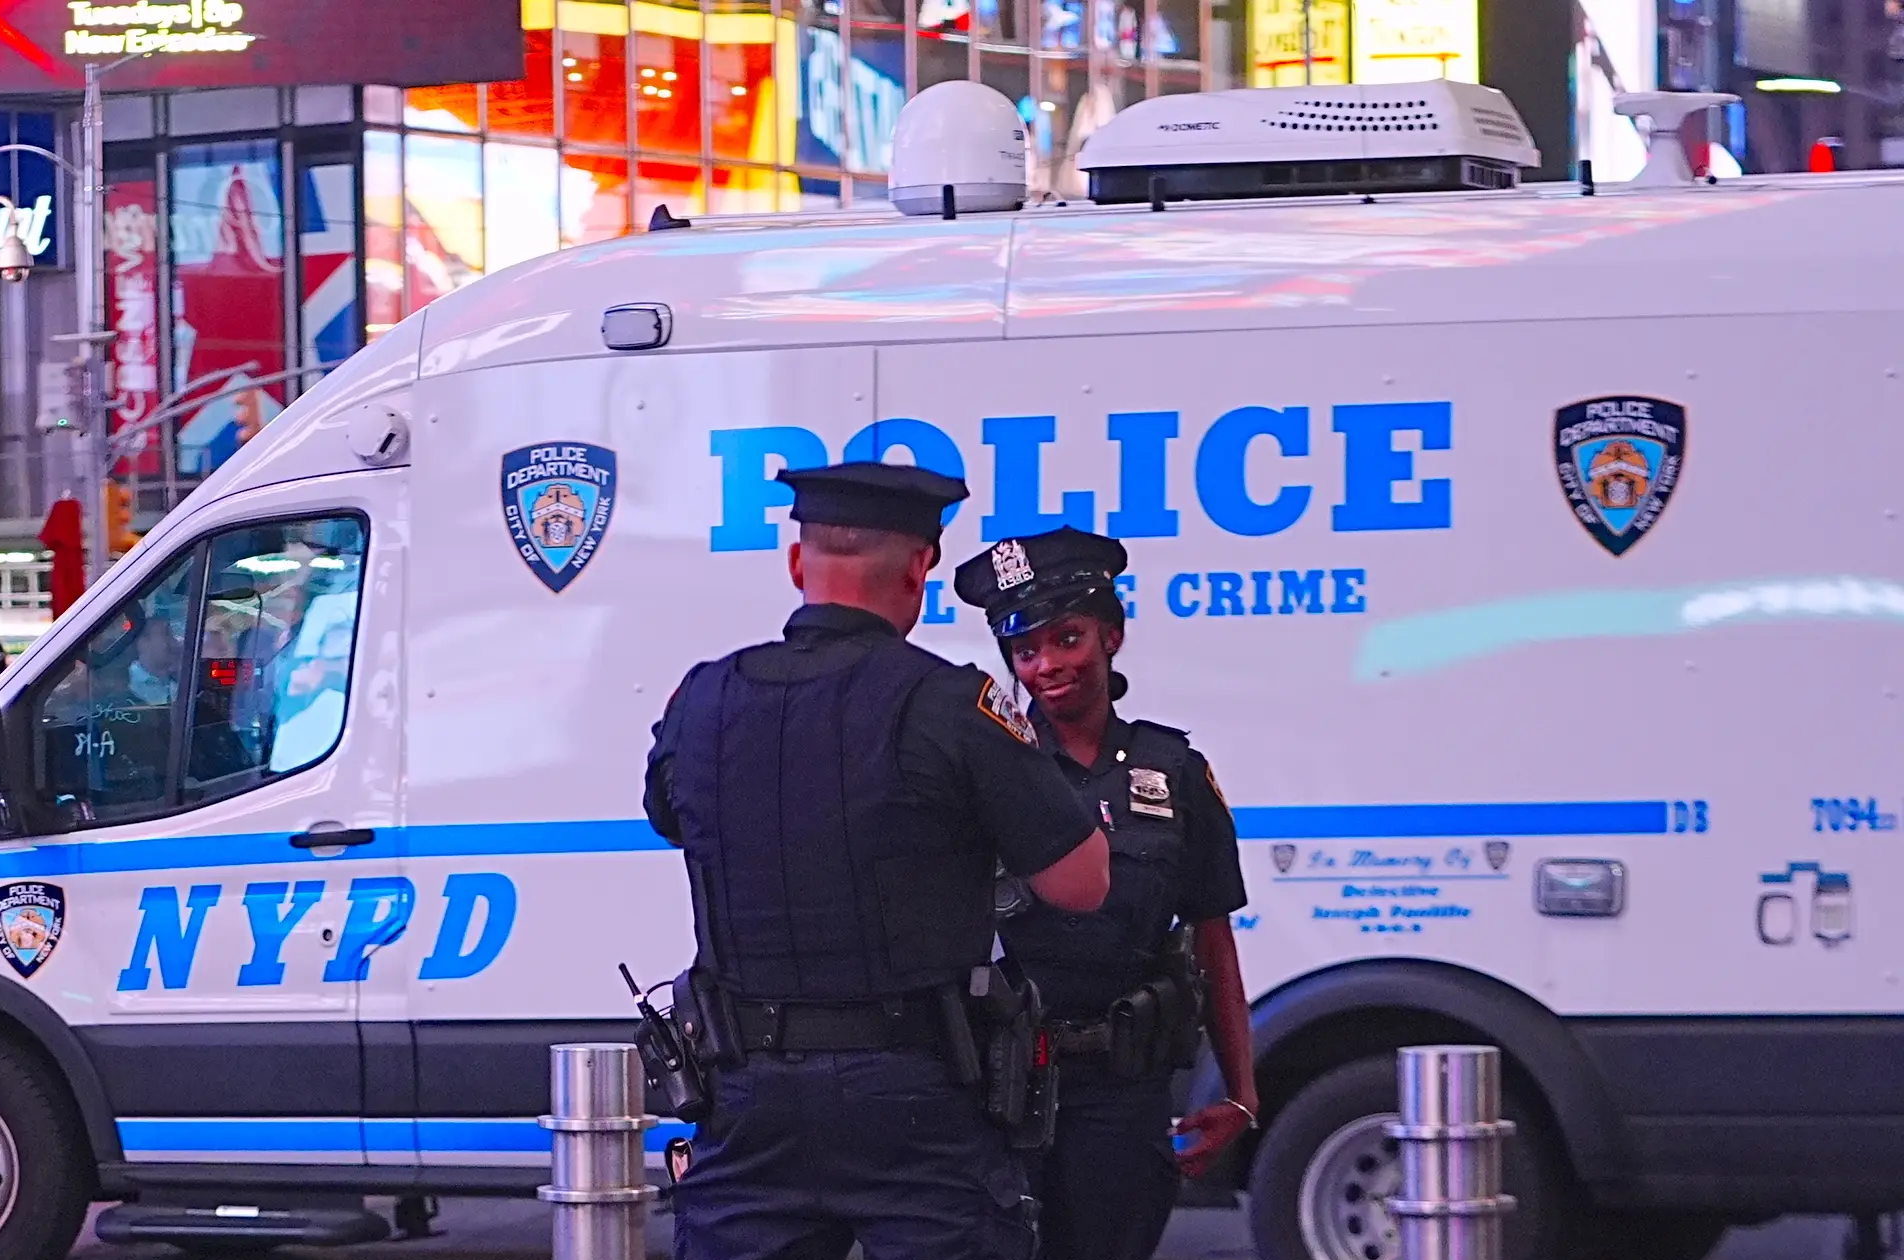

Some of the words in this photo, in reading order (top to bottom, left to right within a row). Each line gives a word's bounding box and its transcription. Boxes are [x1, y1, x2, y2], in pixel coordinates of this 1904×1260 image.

[65, 30, 126, 54] New
[1586, 401, 1654, 419] POLICE
[1560, 417, 1680, 447] DEPARTMENT
[530, 446, 588, 464] POLICE
[507, 462, 610, 489] DEPARTMENT
[506, 504, 527, 540] CITY
[520, 544, 541, 562] OF
[571, 535, 597, 569] NEW
[591, 497, 611, 533] YORK
[1166, 567, 1367, 617] CRIME
[1348, 849, 1433, 874] Memory
[9, 885, 45, 896] POLICE
[1342, 884, 1440, 898] Detective
[117, 873, 517, 991] NYPD
[2, 947, 16, 959] OF
